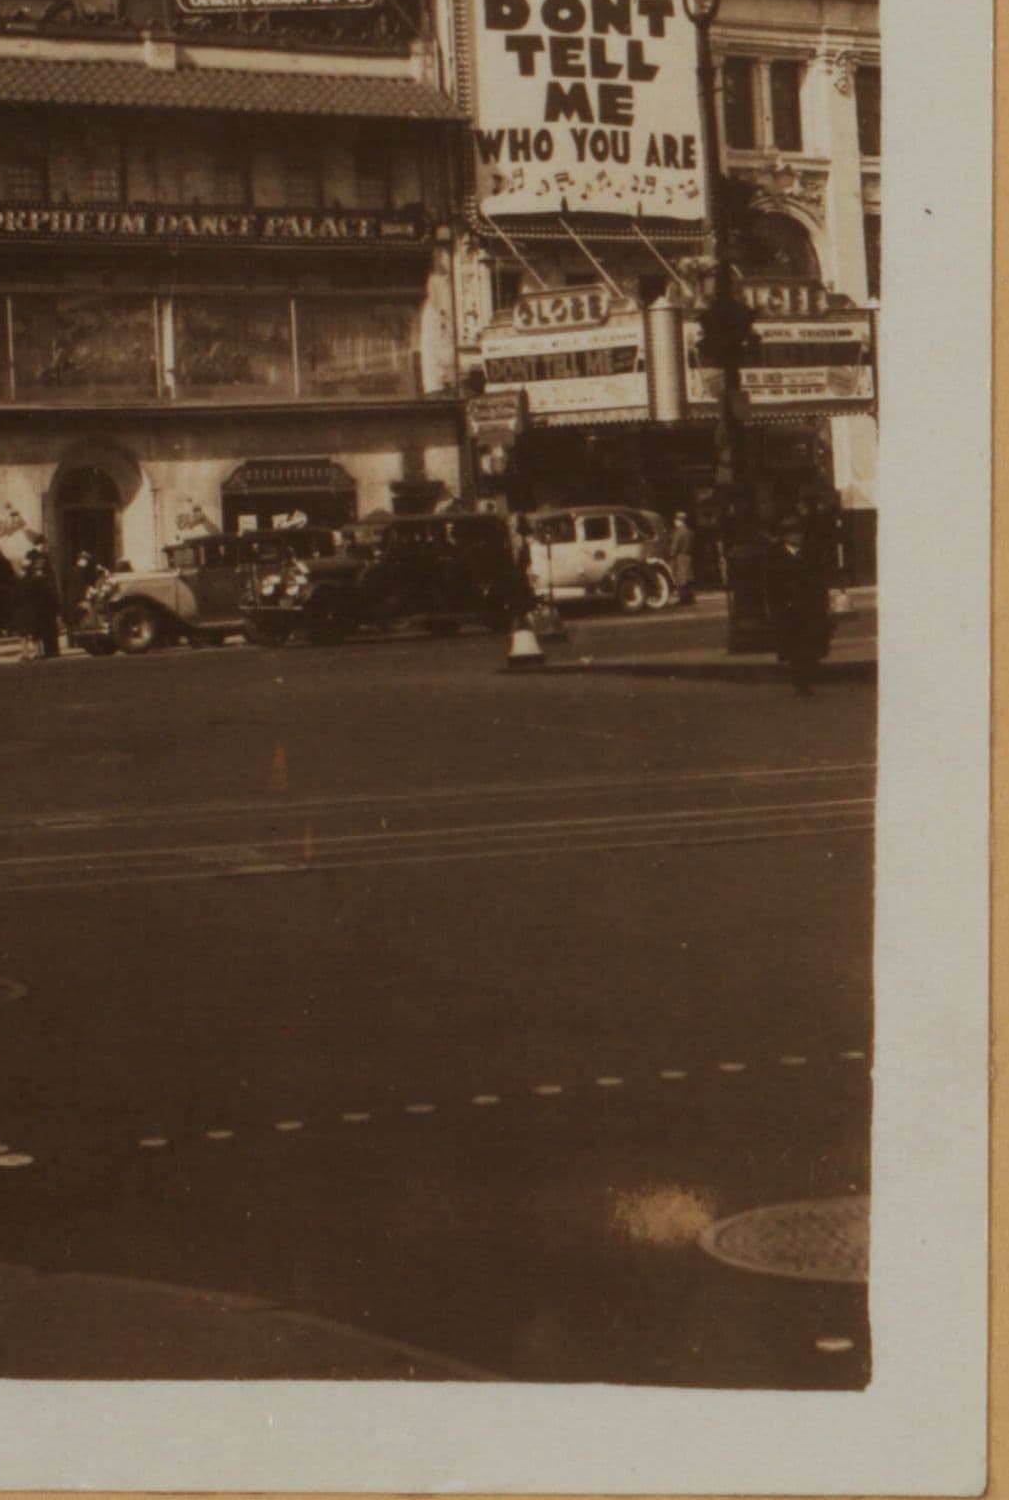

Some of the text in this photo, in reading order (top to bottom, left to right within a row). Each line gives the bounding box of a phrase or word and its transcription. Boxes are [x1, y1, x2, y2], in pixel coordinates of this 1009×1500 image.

[505, 35, 661, 81] TELL
[544, 82, 635, 127] ME
[477, 128, 697, 169] WHO YOU ARE
[156, 213, 256, 237] DANCE
[262, 216, 375, 239] PALACE
